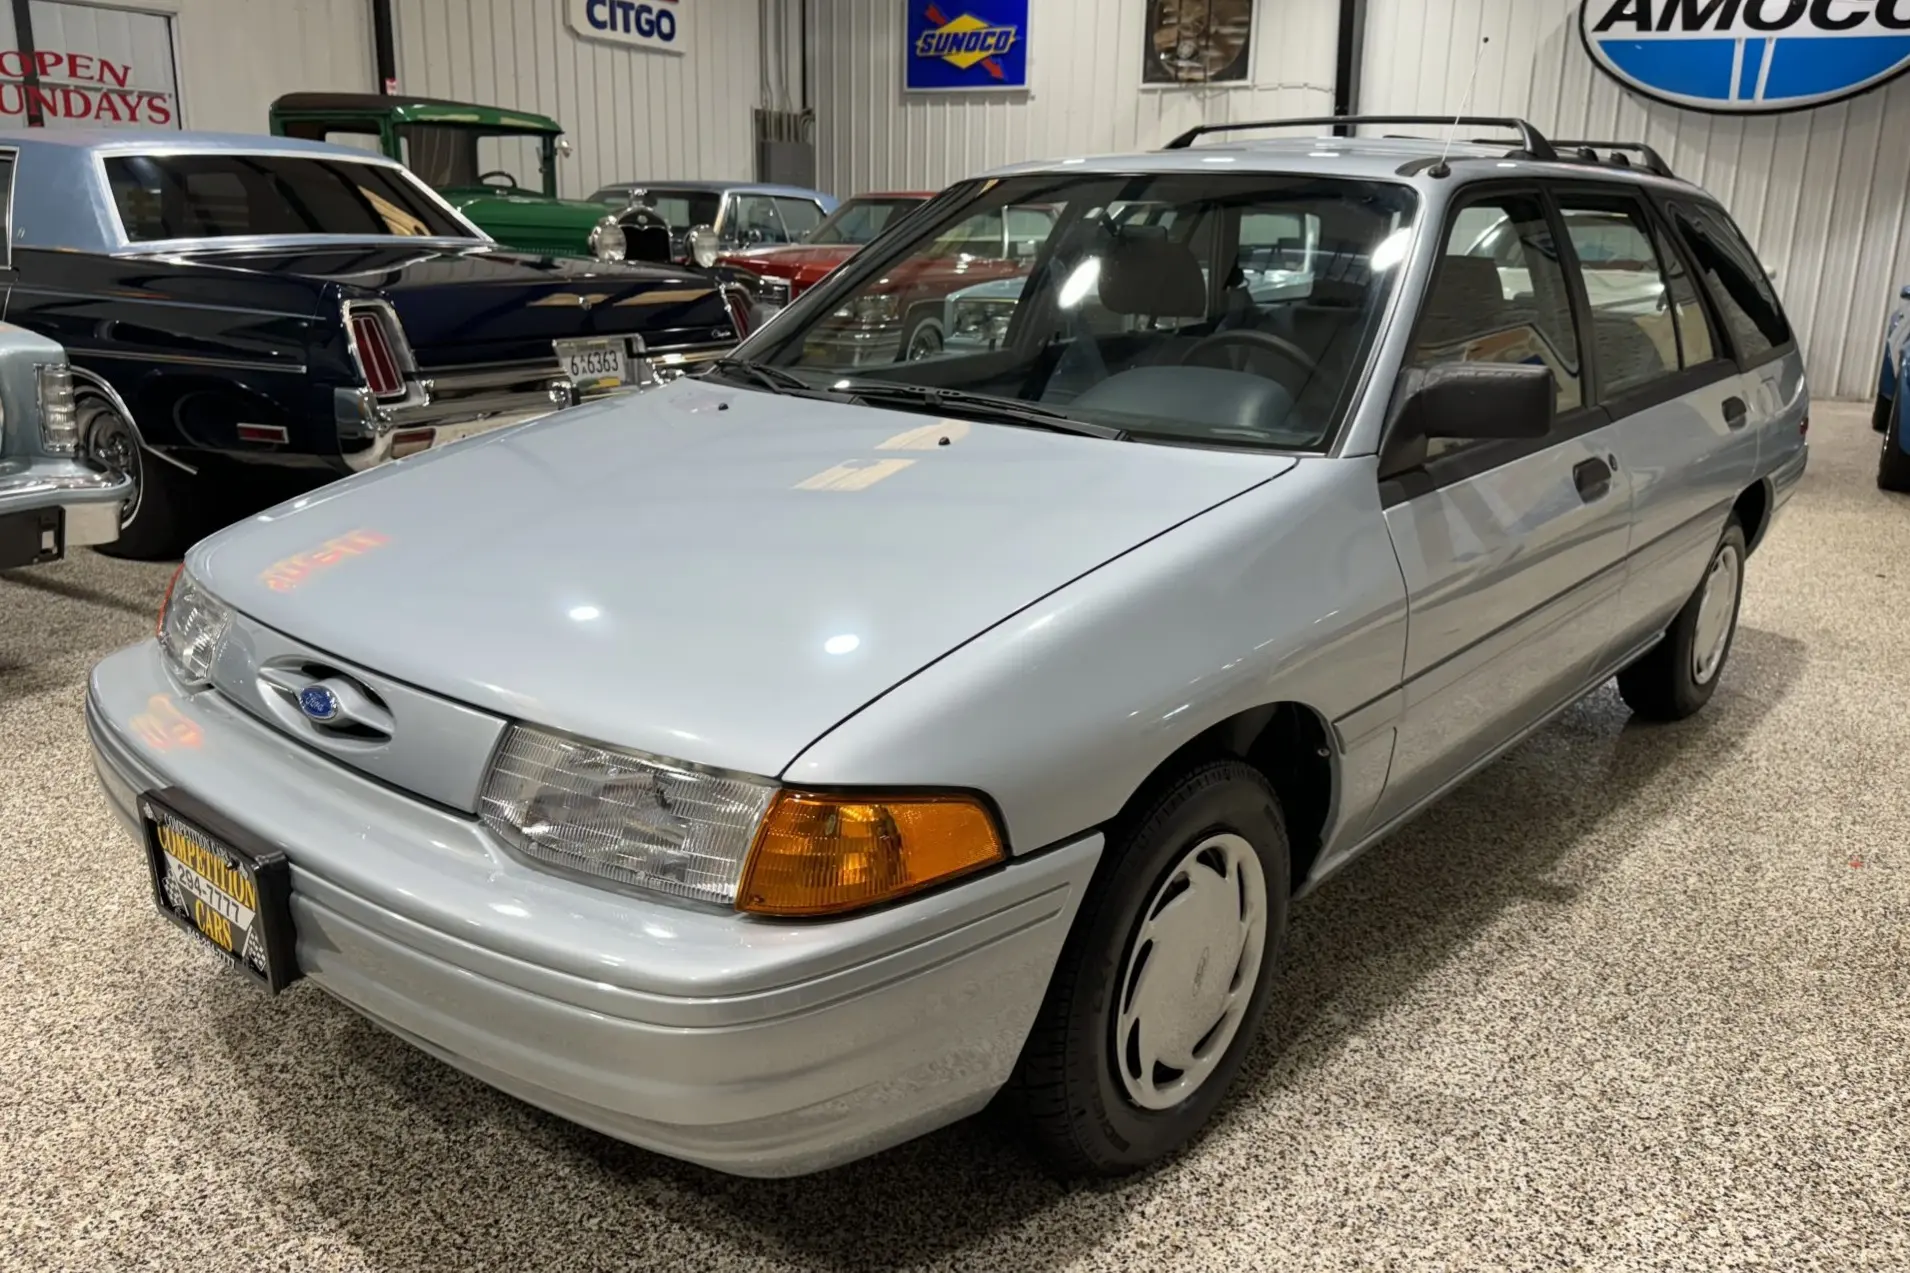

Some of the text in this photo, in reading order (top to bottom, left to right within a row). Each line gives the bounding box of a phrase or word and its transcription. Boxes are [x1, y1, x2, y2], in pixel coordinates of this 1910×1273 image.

[586, 0, 676, 42] CITGO
[917, 29, 1014, 55] SUNOCO
[0, 51, 131, 88] OPEN
[157, 824, 256, 913] COMPETITION
[178, 863, 239, 923] 294-7777
[196, 899, 233, 952] CARS
